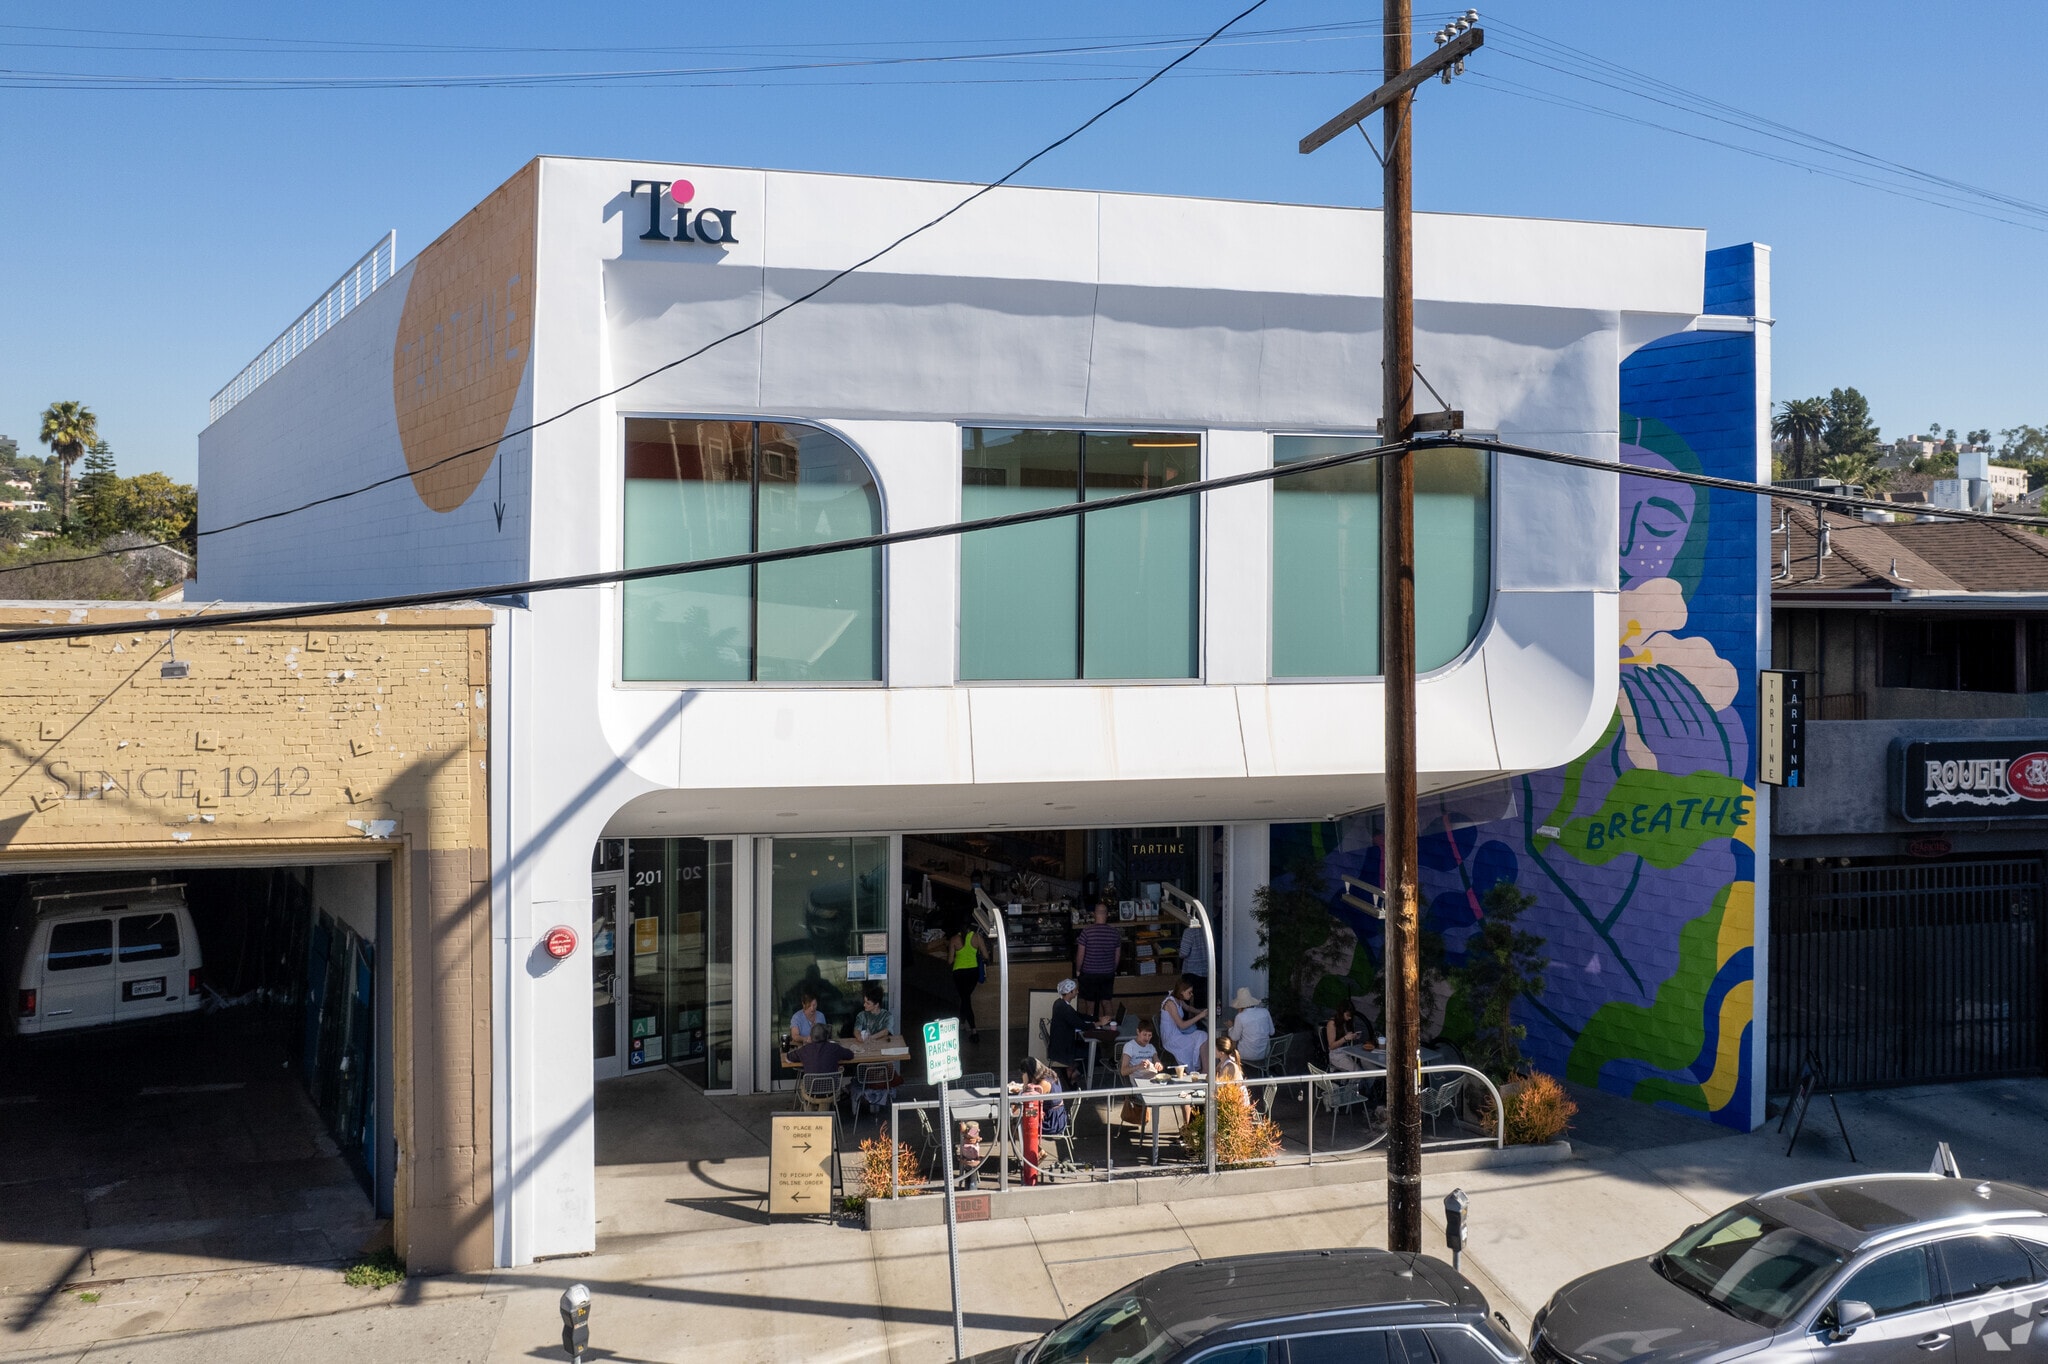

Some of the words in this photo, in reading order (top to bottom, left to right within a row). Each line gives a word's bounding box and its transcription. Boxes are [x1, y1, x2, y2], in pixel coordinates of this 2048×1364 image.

[630, 179, 739, 244] Tia
[402, 273, 521, 404] TARTINE
[44, 760, 198, 801] SINCE
[219, 765, 312, 798] 1942
[1925, 758, 2011, 796] ROUGH
[1586, 795, 1754, 850] BREATHE
[1131, 843, 1185, 855] TARTINE
[635, 869, 662, 886] 201
[635, 1022, 646, 1034] A
[928, 1025, 937, 1041] 2
[940, 1023, 956, 1034] HOUR
[928, 1038, 957, 1057] PARKING
[929, 1059, 941, 1070] 8AM
[946, 1055, 958, 1065] 8PM
